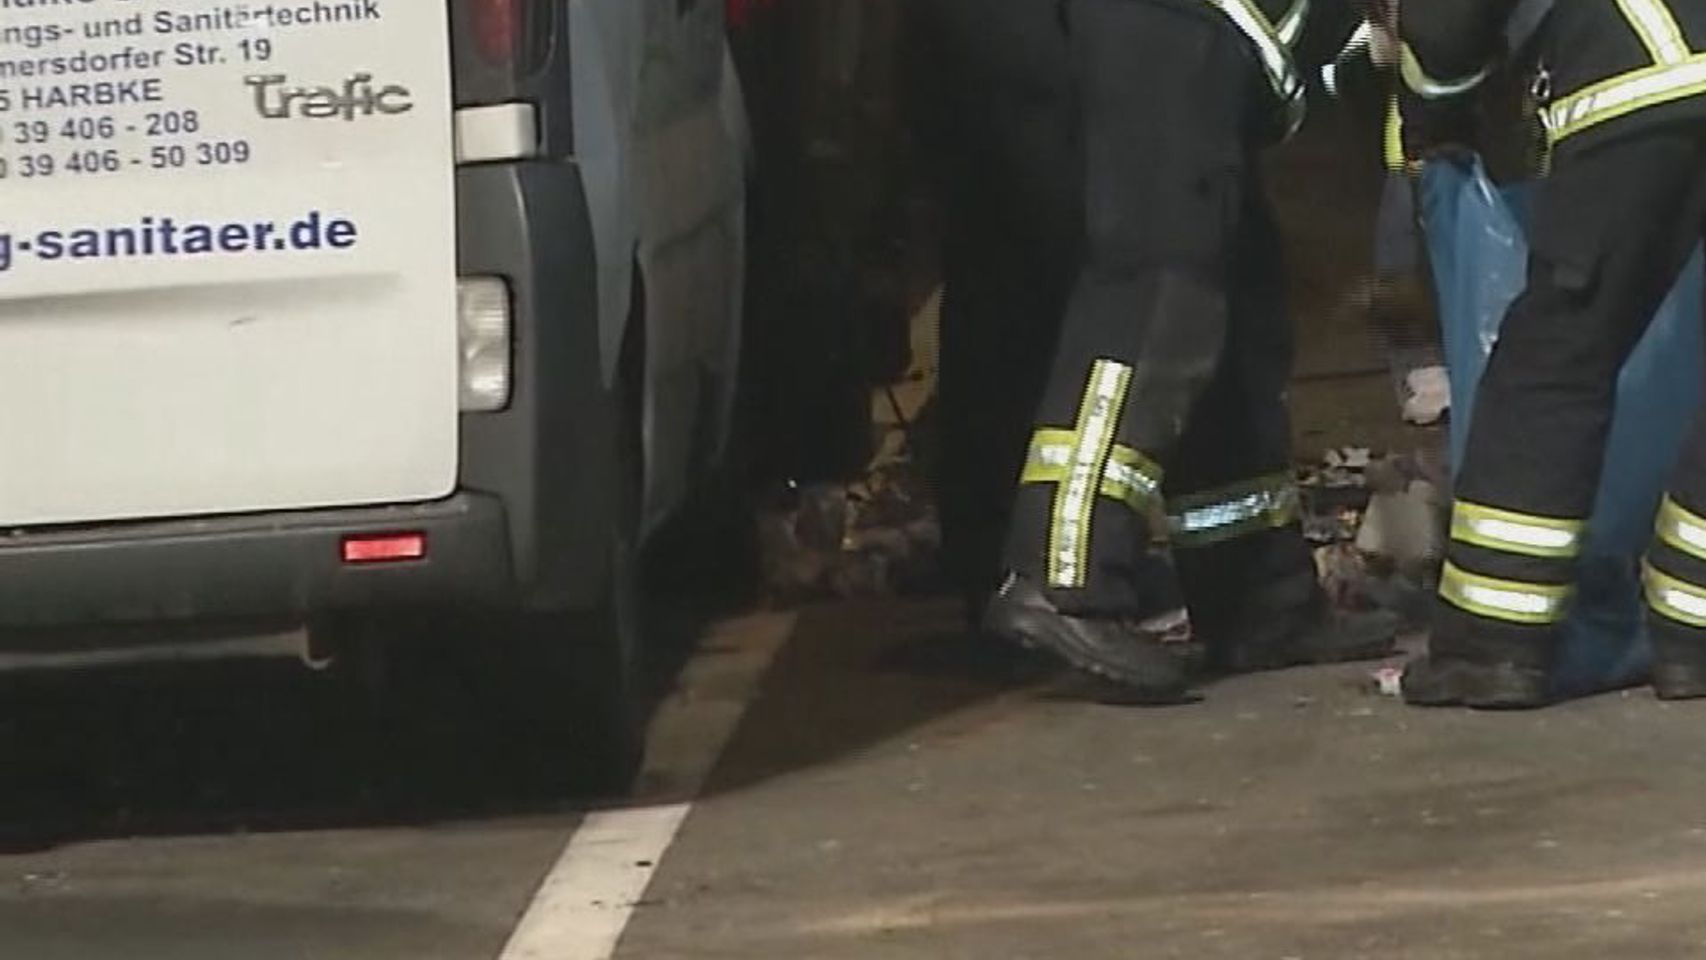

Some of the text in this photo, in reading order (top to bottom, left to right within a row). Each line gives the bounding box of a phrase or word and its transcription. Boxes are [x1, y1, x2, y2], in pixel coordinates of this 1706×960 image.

[83, 12, 143, 40] und
[174, 43, 227, 66] Str.
[238, 38, 273, 62] 19
[22, 78, 163, 109] HARBKE
[243, 73, 414, 122] Trafic
[14, 121, 49, 144] 39
[59, 116, 115, 140] 406
[145, 110, 200, 136] 208
[19, 154, 55, 178] 39
[65, 149, 121, 174] 406
[150, 145, 186, 169] 50
[198, 140, 251, 165] 309
